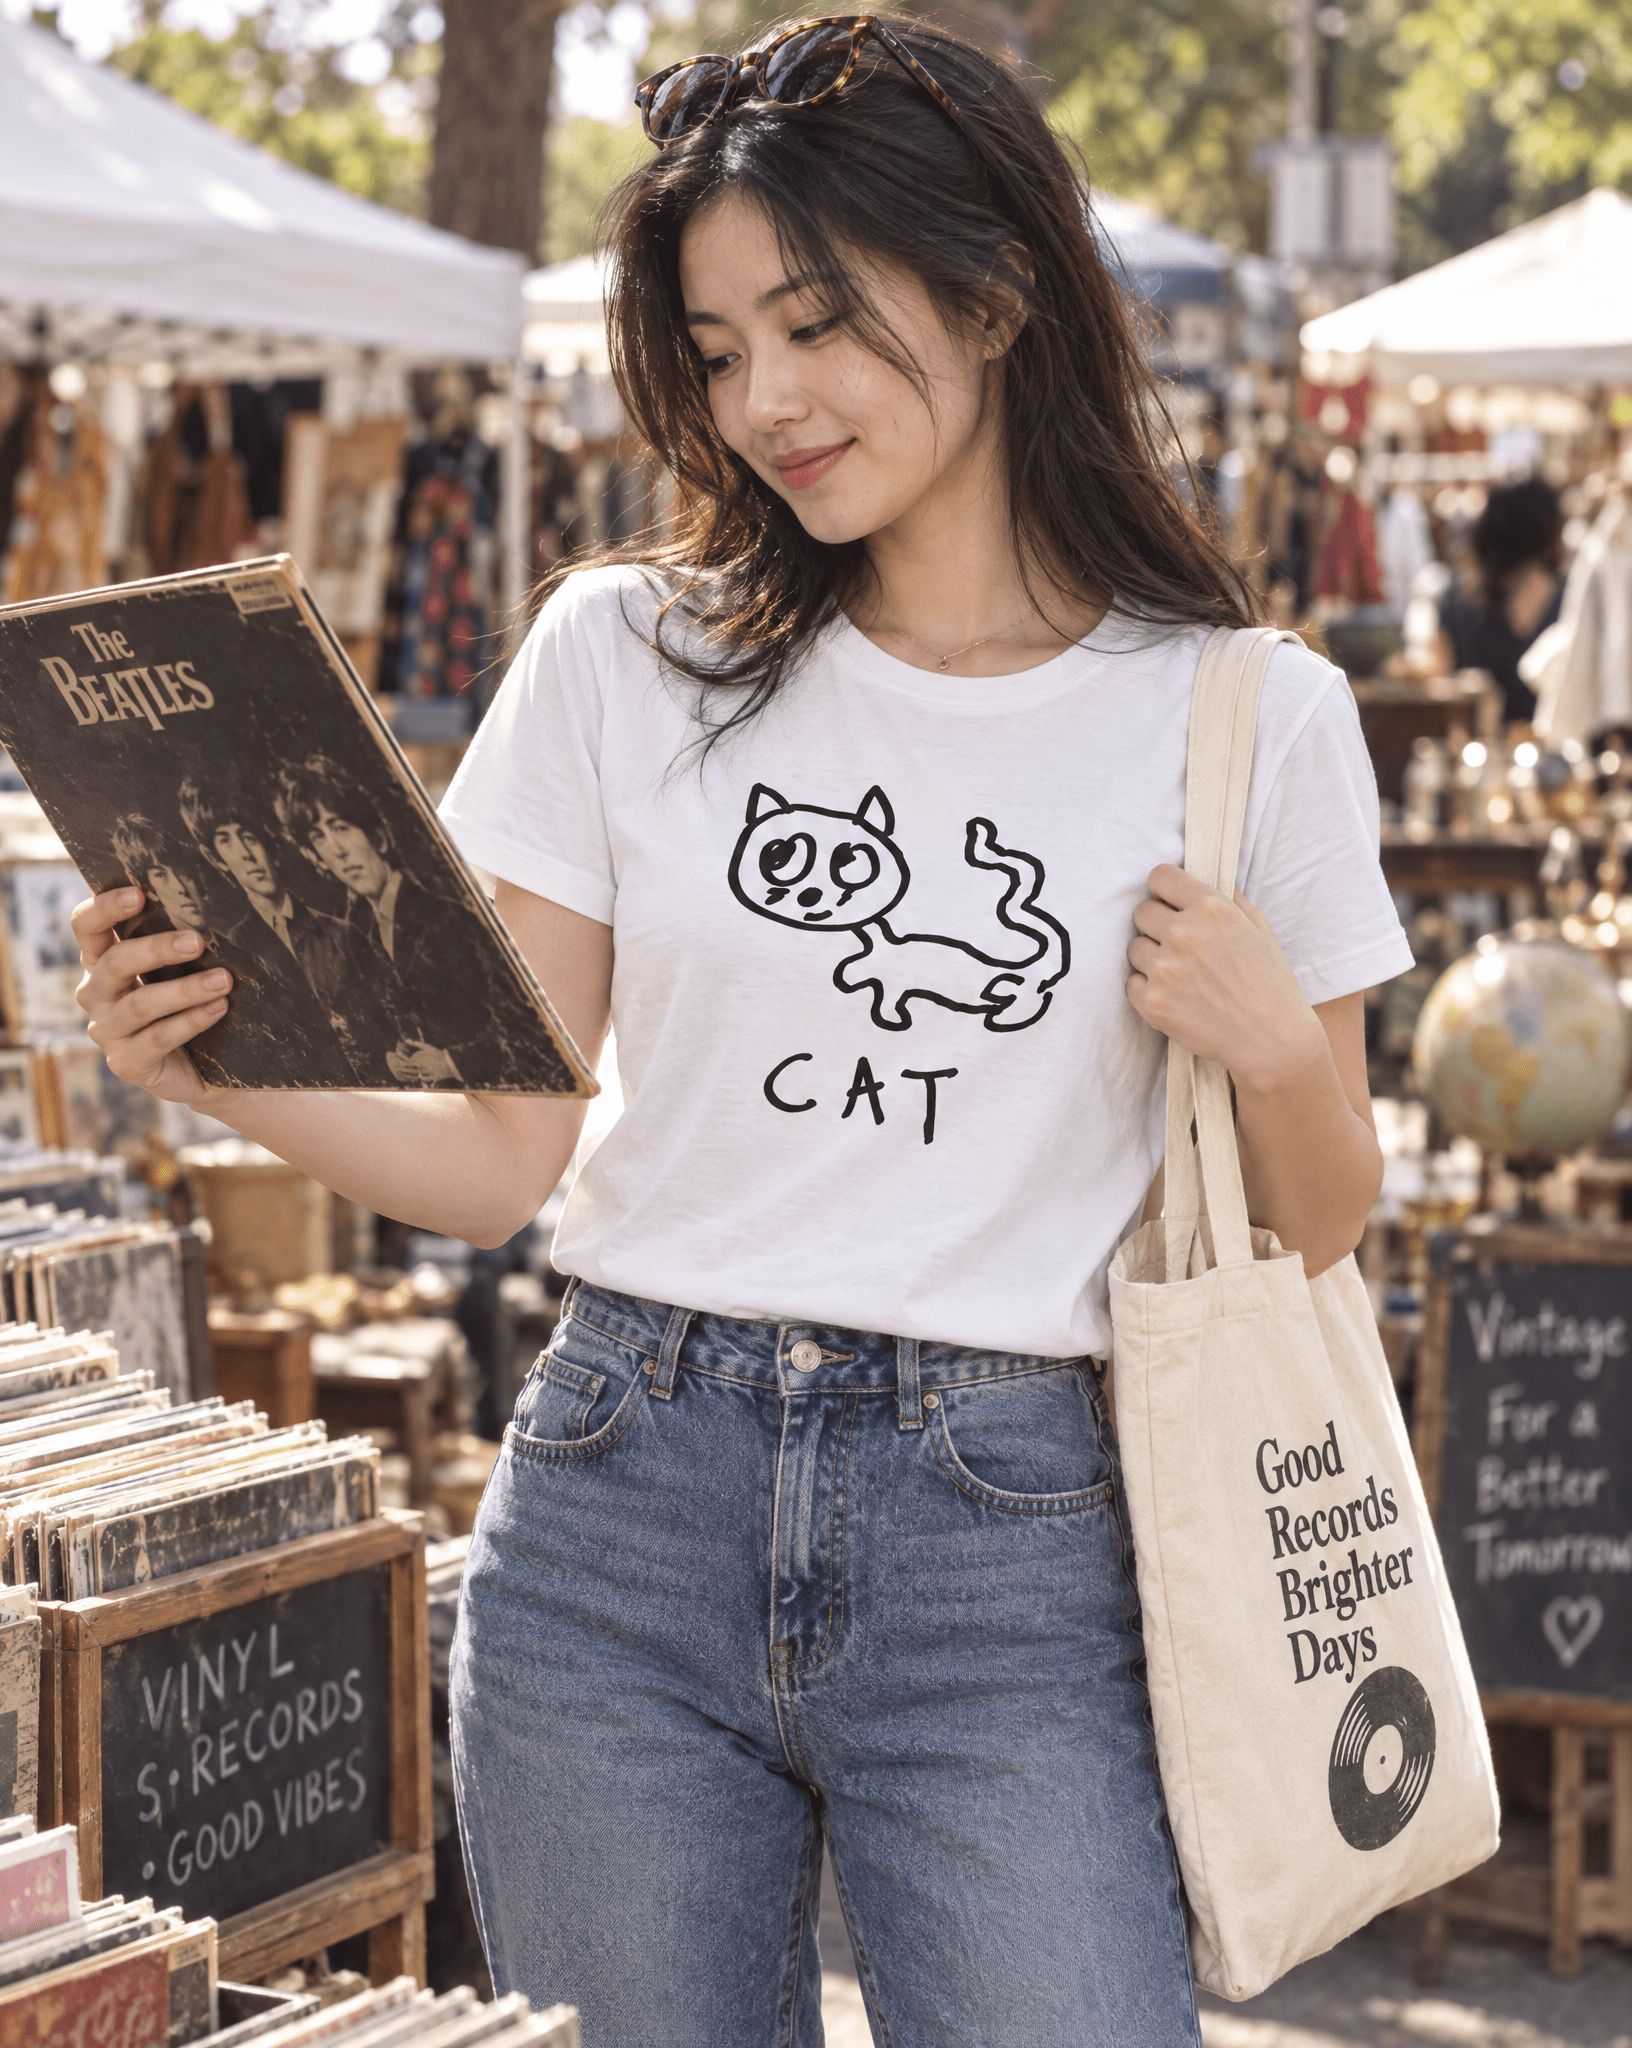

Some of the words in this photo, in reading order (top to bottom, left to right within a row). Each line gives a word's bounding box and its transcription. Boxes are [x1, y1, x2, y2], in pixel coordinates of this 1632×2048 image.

[70, 622, 135, 663] The
[40, 656, 215, 731] BEATLES
[763, 1052, 959, 1145] CAT
[1467, 1291, 1627, 1379] Vintage
[1488, 1382, 1558, 1445] For
[1569, 1401, 1599, 1439] a
[1256, 1420, 1345, 1494] Good
[1476, 1456, 1610, 1513] Better
[1265, 1475, 1398, 1560] Records
[1276, 1546, 1413, 1622] Brighter
[141, 1623, 295, 1733] VINYL
[1287, 1626, 1378, 1684] Days
[273, 1747, 367, 1837] VIBES
